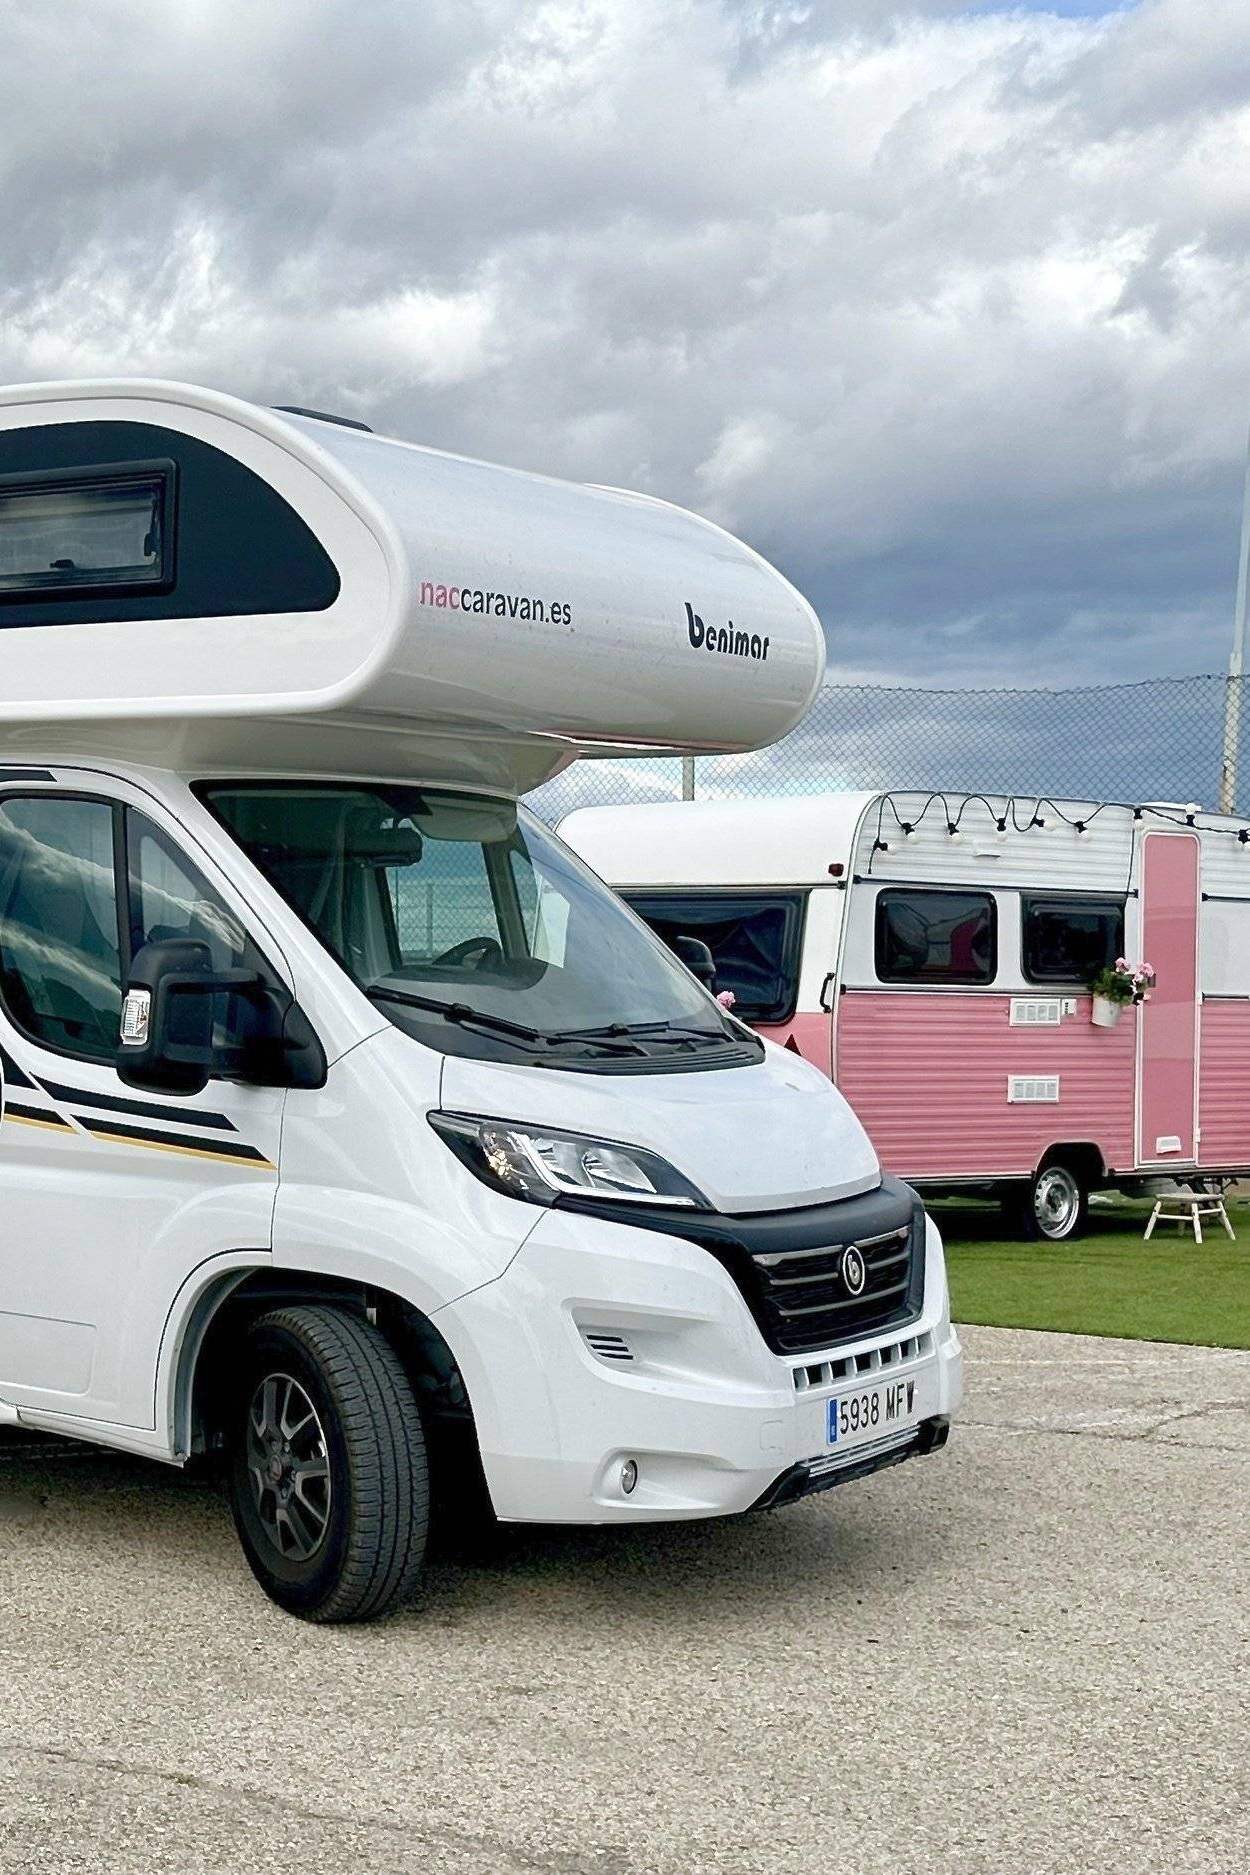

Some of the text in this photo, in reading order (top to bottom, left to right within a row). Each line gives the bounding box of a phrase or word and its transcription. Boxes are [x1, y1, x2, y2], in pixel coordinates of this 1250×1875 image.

[420, 581, 572, 625] naccaravan.es
[684, 602, 770, 661] benimar
[840, 1393, 879, 1435] 5938
